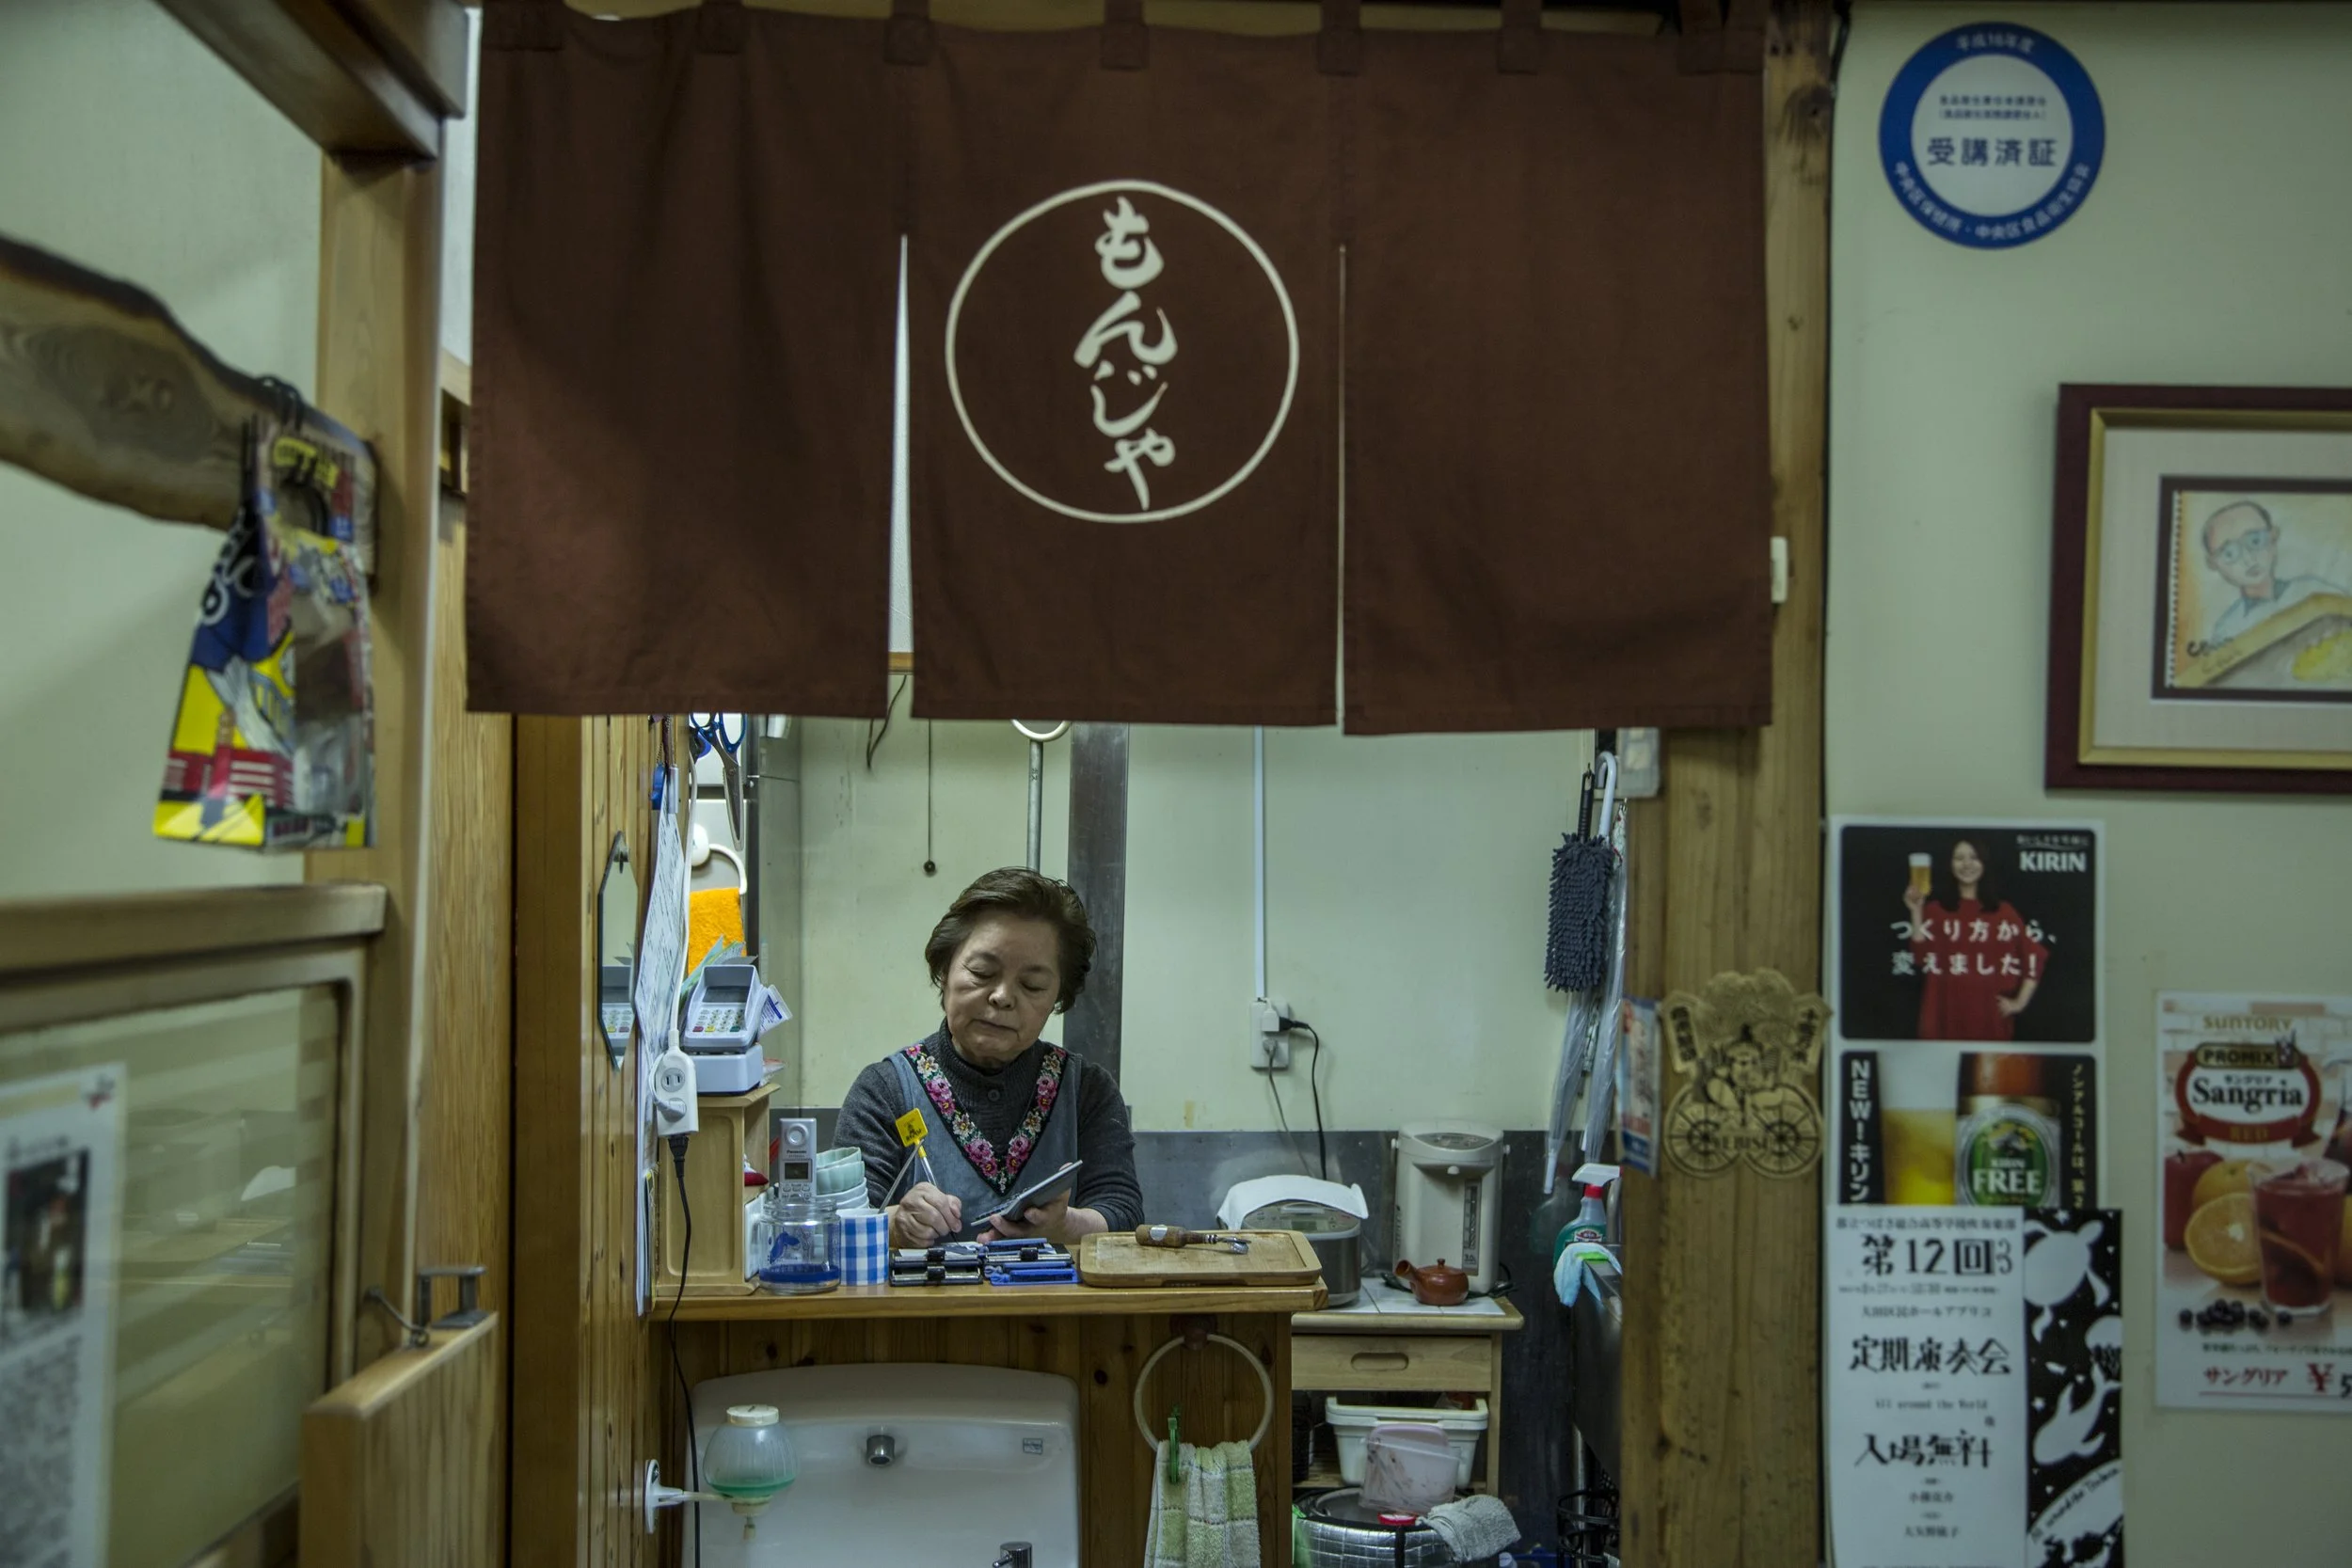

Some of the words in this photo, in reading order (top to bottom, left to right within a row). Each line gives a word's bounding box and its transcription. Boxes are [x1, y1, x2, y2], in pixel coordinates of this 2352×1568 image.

[1927, 137, 2058, 167] 受講済証
[2019, 851, 2087, 872] KIRIN
[1890, 919, 2058, 943] つくり方から、
[1891, 950, 2038, 976] 変えました!
[2203, 1016, 2293, 1032] SUNTORY
[2203, 1049, 2275, 1065] PROMIX
[2193, 1077, 2303, 1114] Sangria
[1973, 1168, 2042, 1195] FREE
[1849, 1334, 2011, 1375] 定期演奏会
[2203, 1366, 2288, 1386] サングリア
[1854, 1430, 1993, 1468] 入場無料
